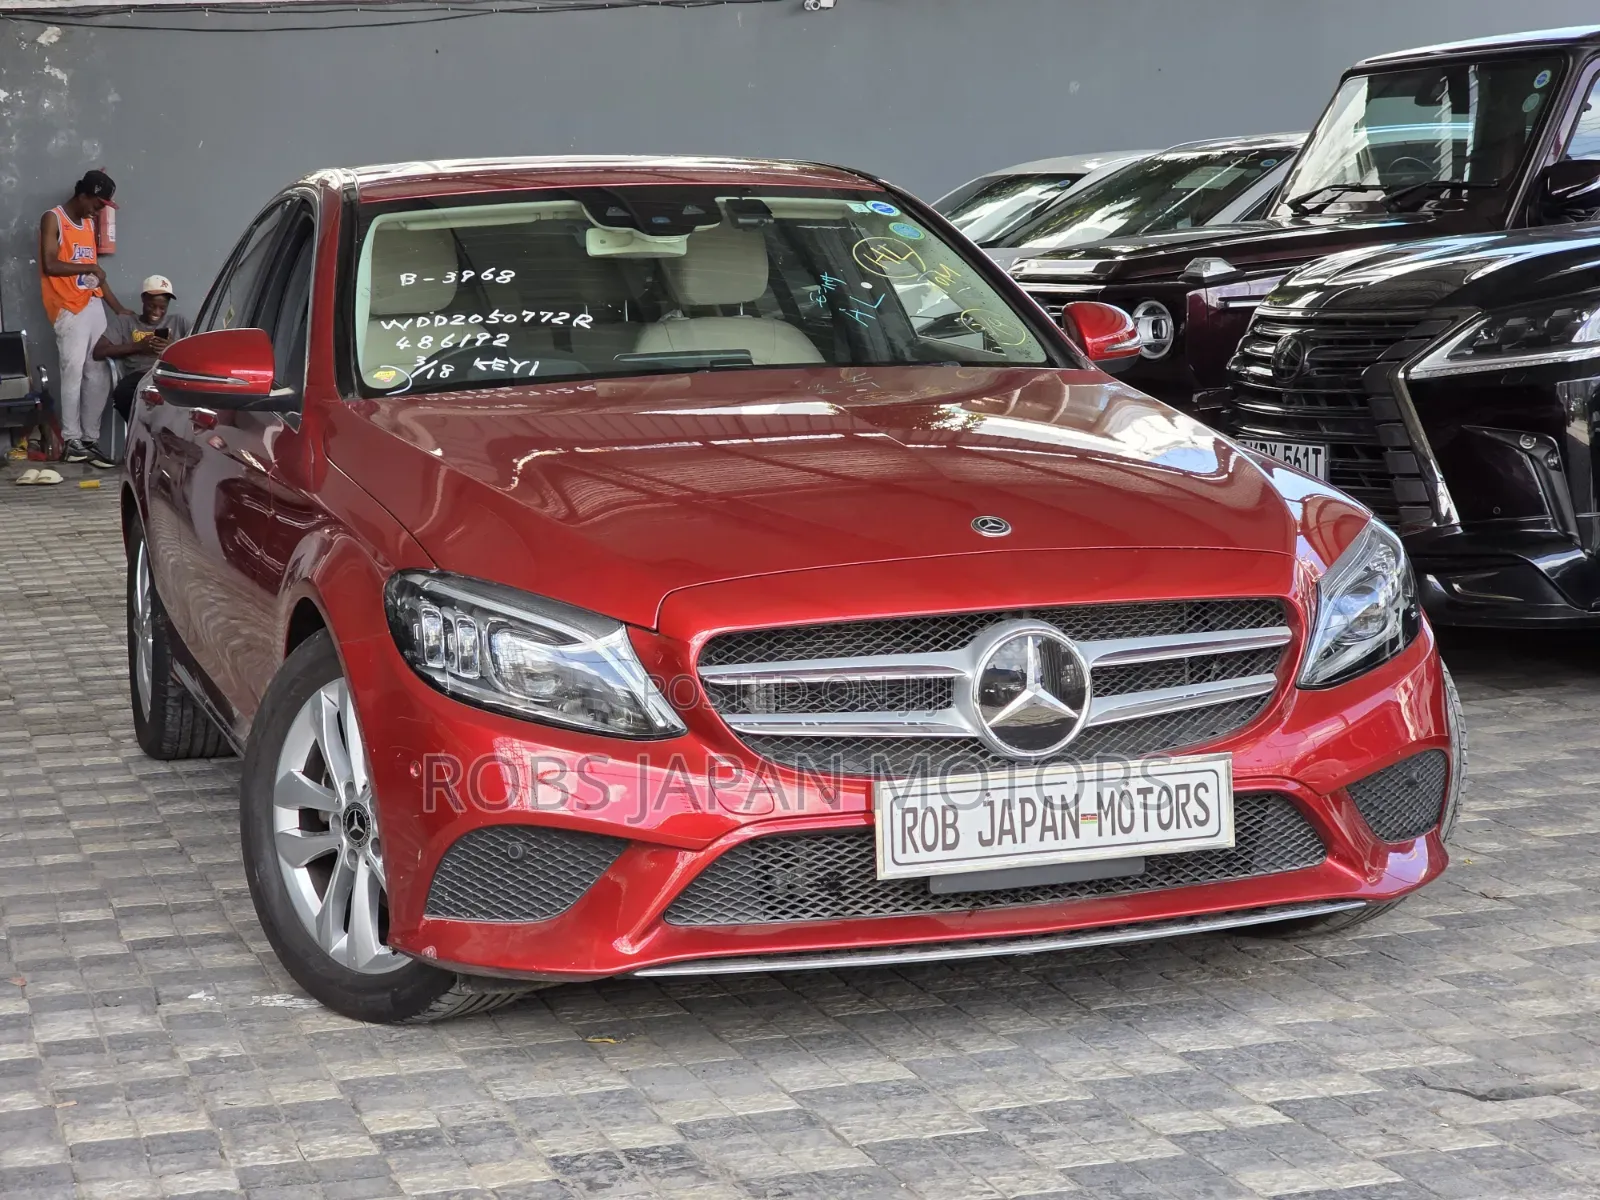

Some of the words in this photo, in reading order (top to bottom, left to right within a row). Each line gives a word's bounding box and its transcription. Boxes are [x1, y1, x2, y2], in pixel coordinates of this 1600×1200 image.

[396, 332, 511, 351] 486192
[900, 804, 961, 855] ROB
[977, 792, 1081, 848] JAPAN
[1097, 781, 1211, 838] MOTORS
